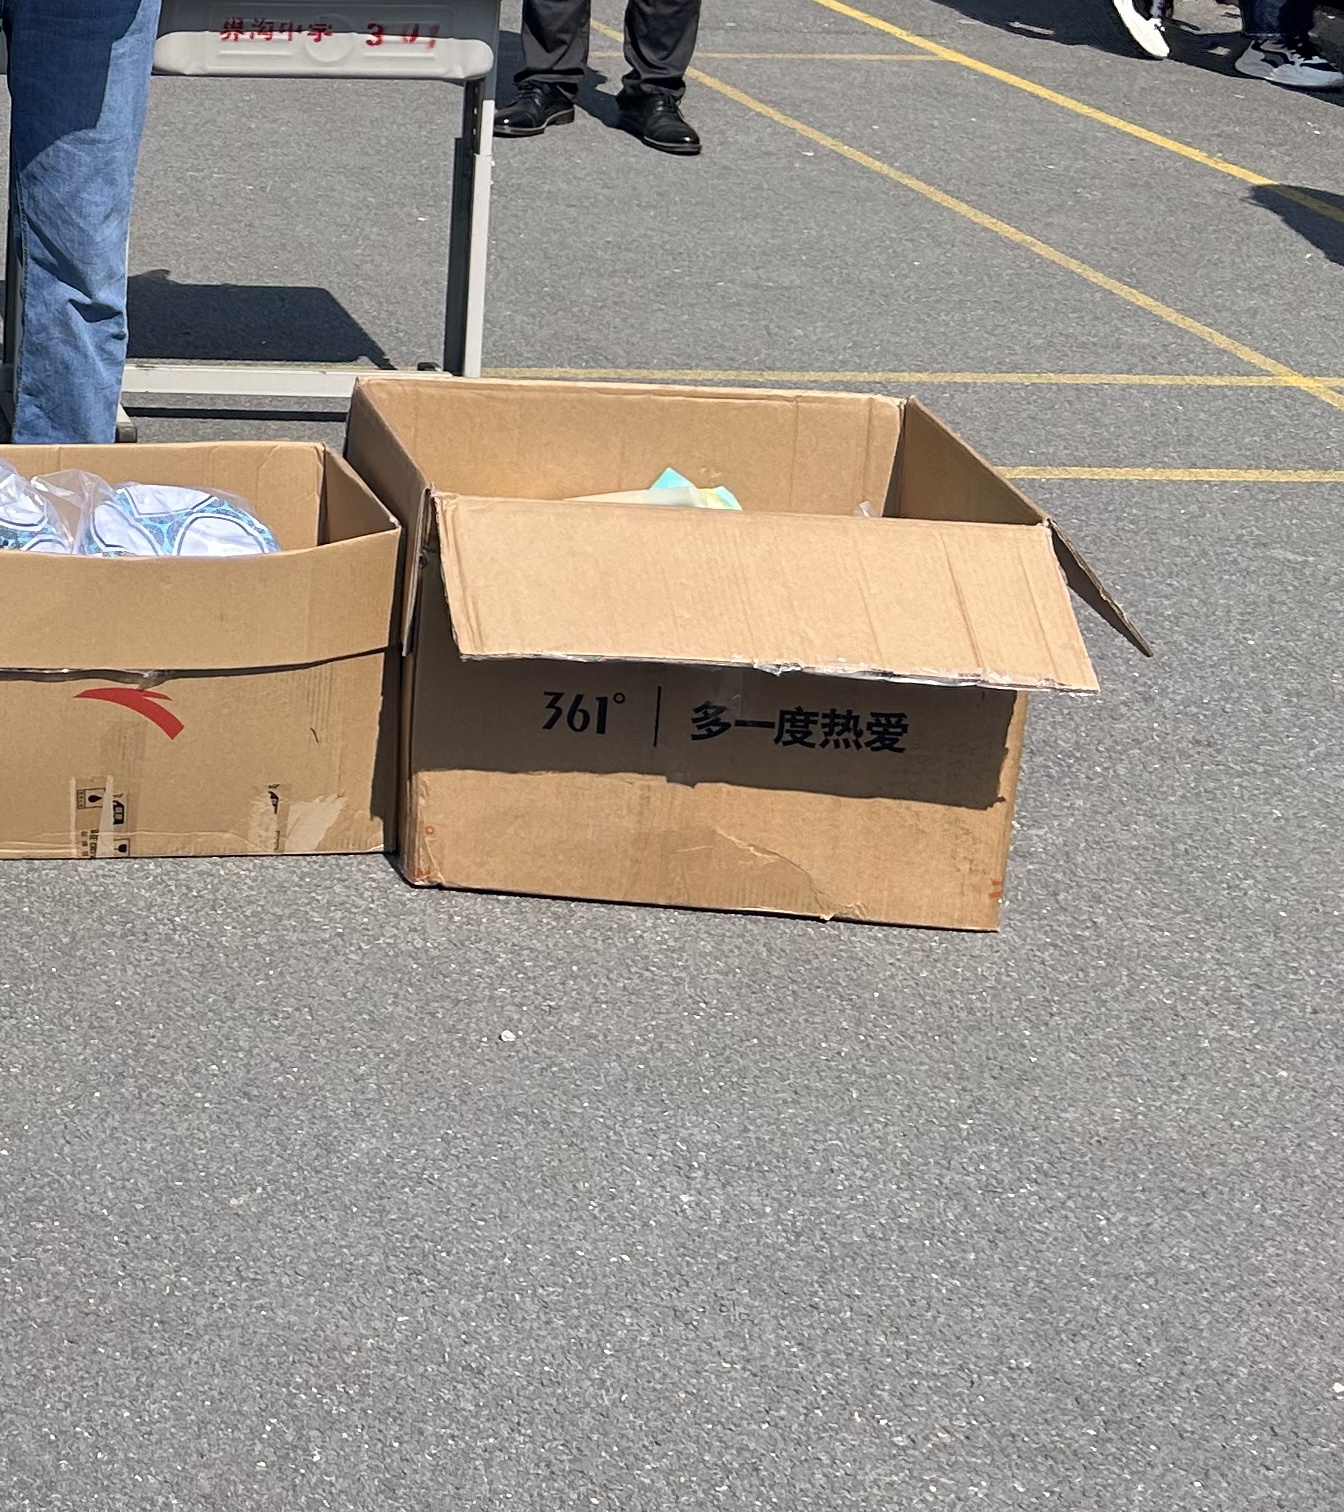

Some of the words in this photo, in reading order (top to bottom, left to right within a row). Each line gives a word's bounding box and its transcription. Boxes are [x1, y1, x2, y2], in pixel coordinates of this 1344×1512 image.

[690, 700, 910, 754] 多一度热爱
